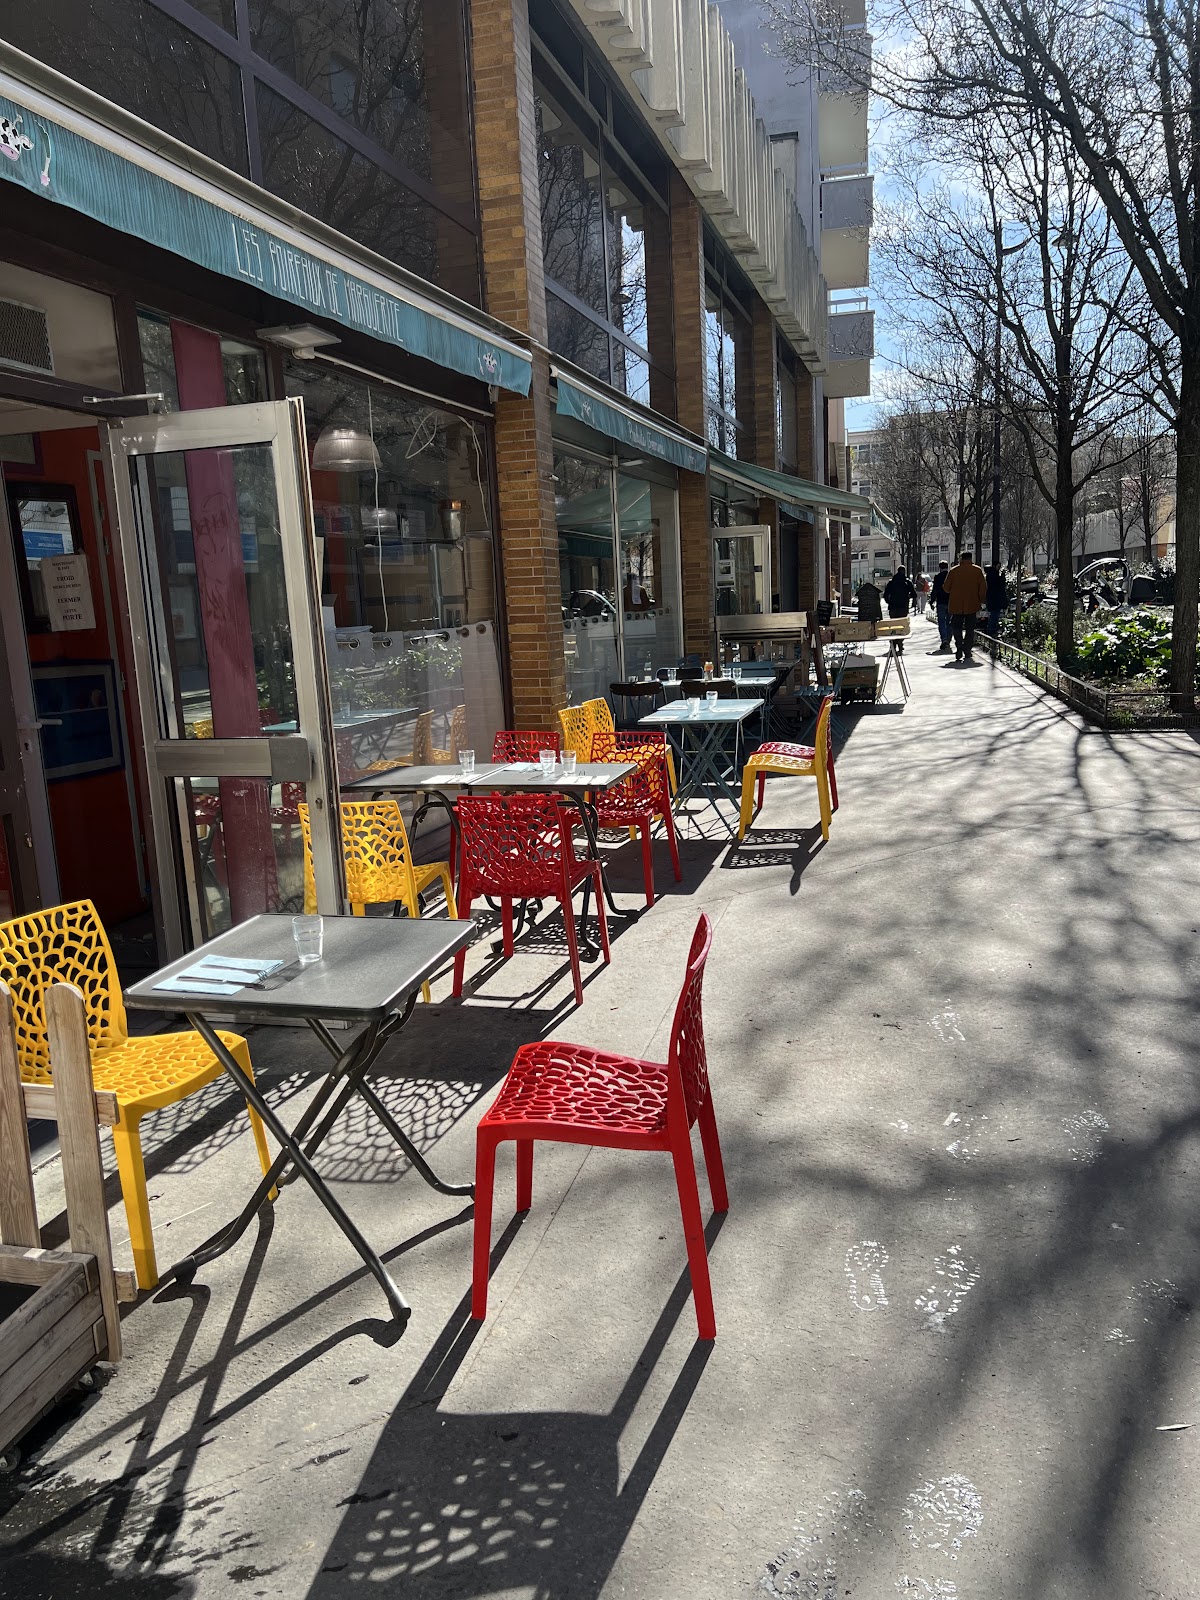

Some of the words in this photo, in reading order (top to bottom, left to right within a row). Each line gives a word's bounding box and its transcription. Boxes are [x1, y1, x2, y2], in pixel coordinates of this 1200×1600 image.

[231, 223, 264, 282] LES
[269, 240, 326, 309] POIREAUX
[326, 269, 343, 317] DE
[343, 277, 404, 343] MARGUERITE
